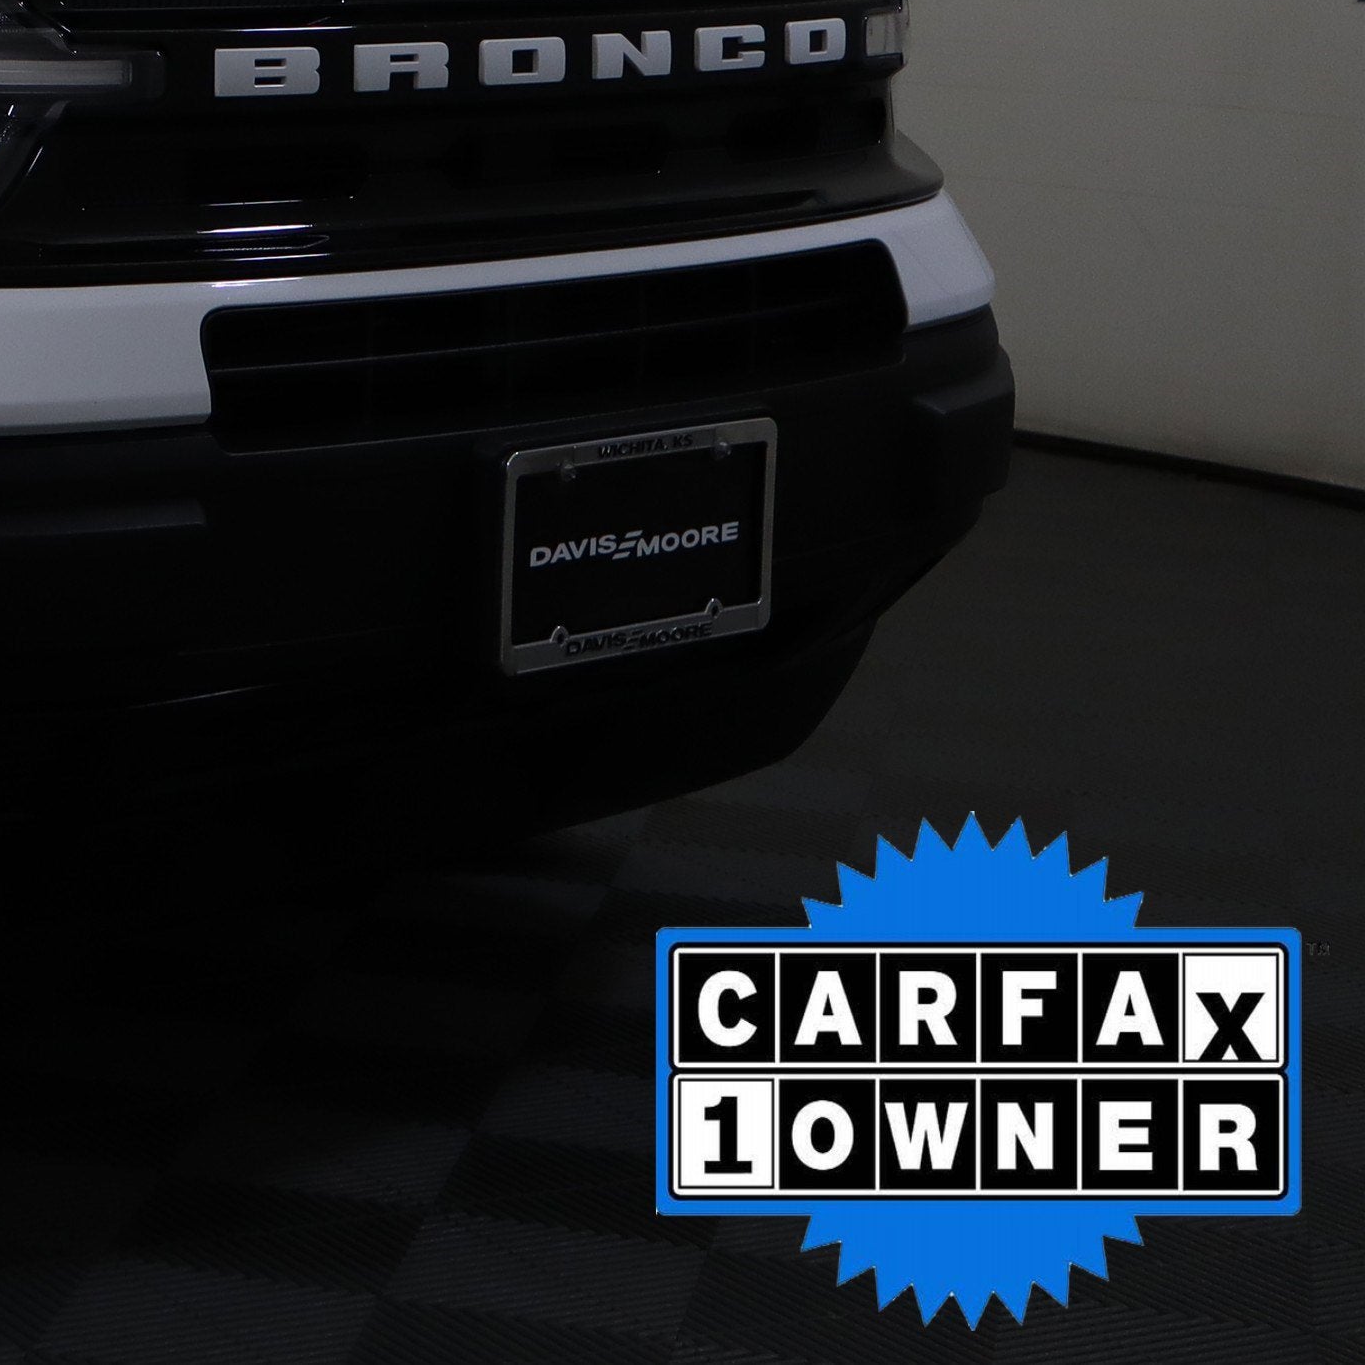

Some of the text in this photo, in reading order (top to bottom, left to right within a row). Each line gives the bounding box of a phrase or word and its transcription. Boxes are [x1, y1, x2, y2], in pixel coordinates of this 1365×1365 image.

[213, 17, 847, 98] BRONCO
[673, 435, 693, 448] KS
[529, 521, 740, 567] DAVIS MOORE
[565, 623, 713, 657] DAVIS MOORE
